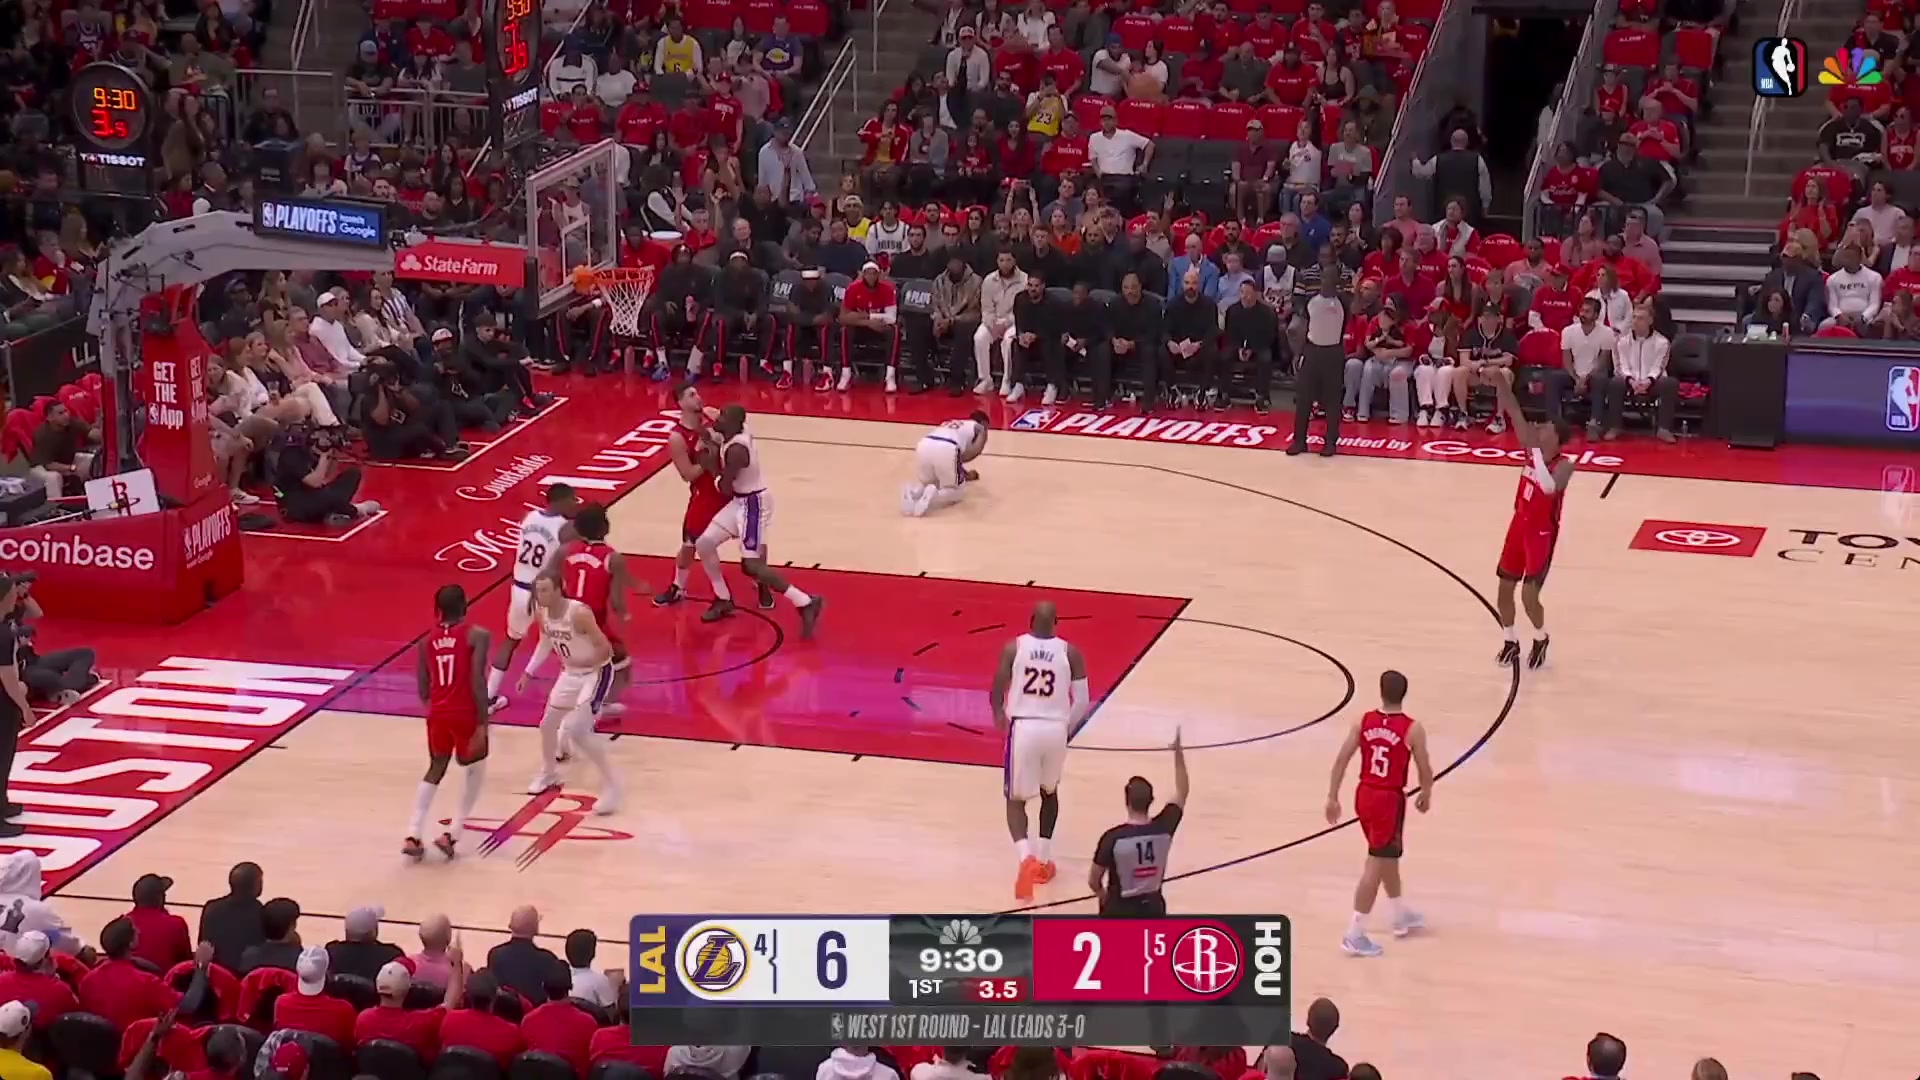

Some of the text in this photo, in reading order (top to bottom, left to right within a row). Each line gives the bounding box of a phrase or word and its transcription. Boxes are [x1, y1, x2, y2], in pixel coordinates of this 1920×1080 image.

[93, 87, 137, 110] 9:30
[98, 153, 146, 167] TISSOT
[275, 203, 338, 235] PLAYOFFS
[339, 222, 376, 239] Google
[153, 361, 177, 382] GET
[153, 382, 178, 404] THE
[160, 404, 184, 431] App
[1051, 412, 1278, 446] PLAYOFFS
[1386, 438, 1413, 451] by
[1421, 440, 1624, 467] Goole
[455, 451, 554, 502] Courtside
[191, 504, 231, 557] PLAYOFFS
[0, 532, 154, 571] coinbase
[518, 539, 547, 568] 28
[576, 568, 586, 598] 1
[435, 654, 455, 687] 17
[1023, 667, 1055, 697] 23
[0, 655, 357, 890] OUSTON
[1369, 744, 1390, 778] 15
[1134, 840, 1156, 866] 14
